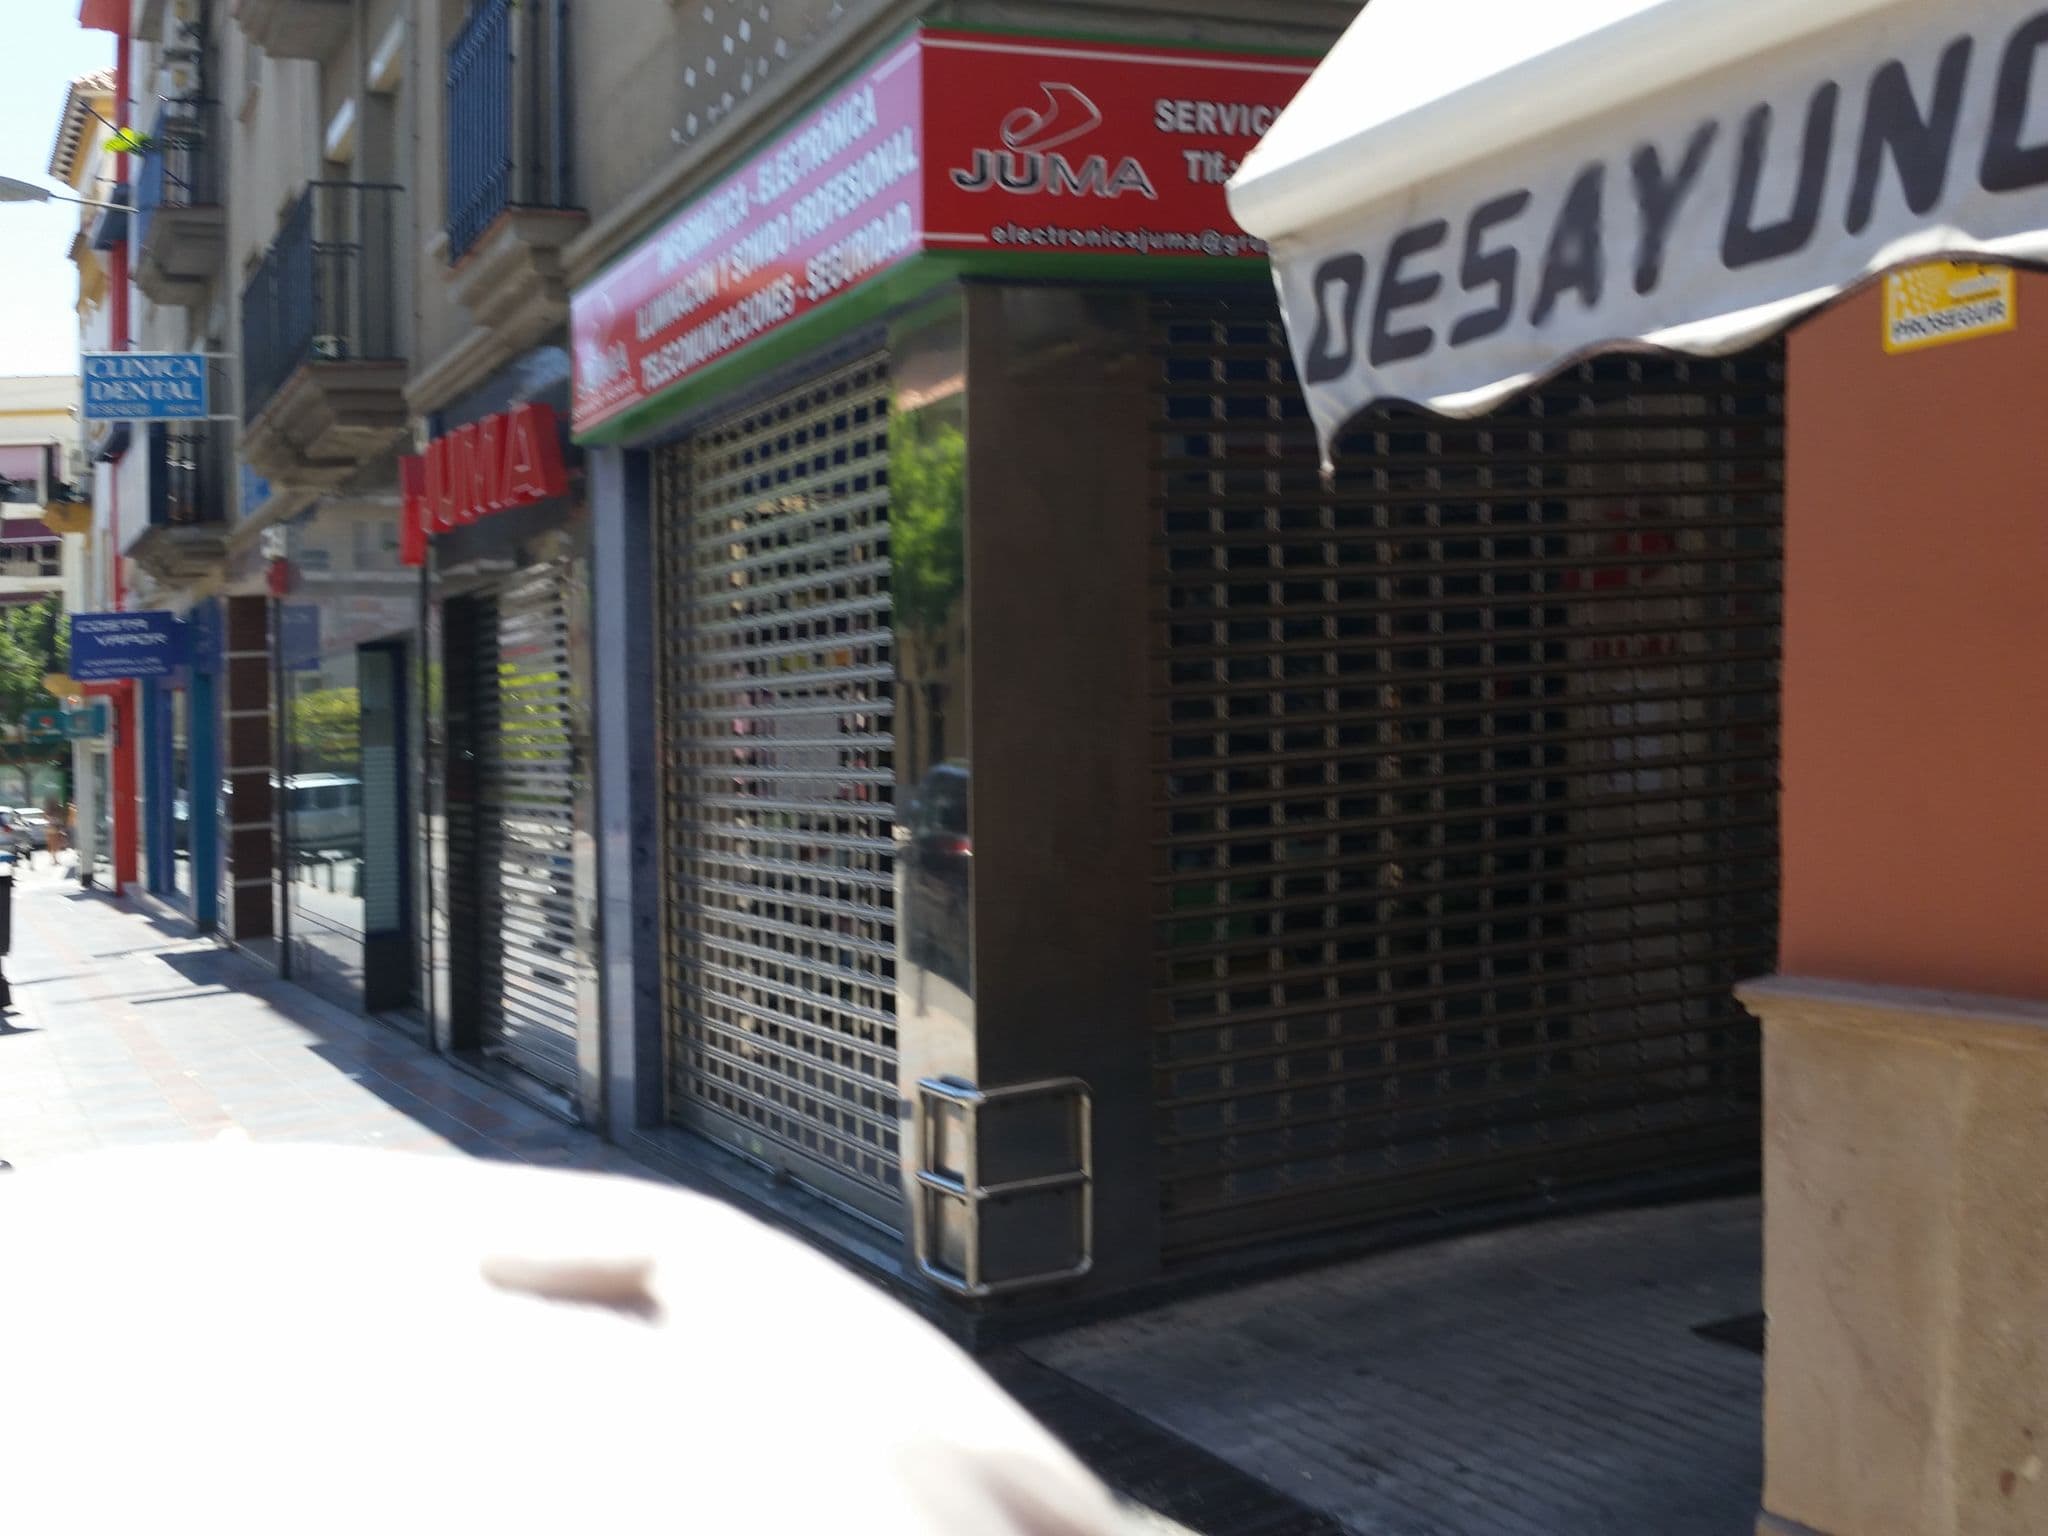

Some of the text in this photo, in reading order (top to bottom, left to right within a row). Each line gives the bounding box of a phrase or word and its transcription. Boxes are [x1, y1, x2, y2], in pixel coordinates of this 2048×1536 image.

[791, 124, 919, 246] PROFESIONAL
[950, 148, 1158, 201] JUMA
[1892, 300, 2007, 338] PROSEGUR
[90, 380, 195, 400] DENTAL
